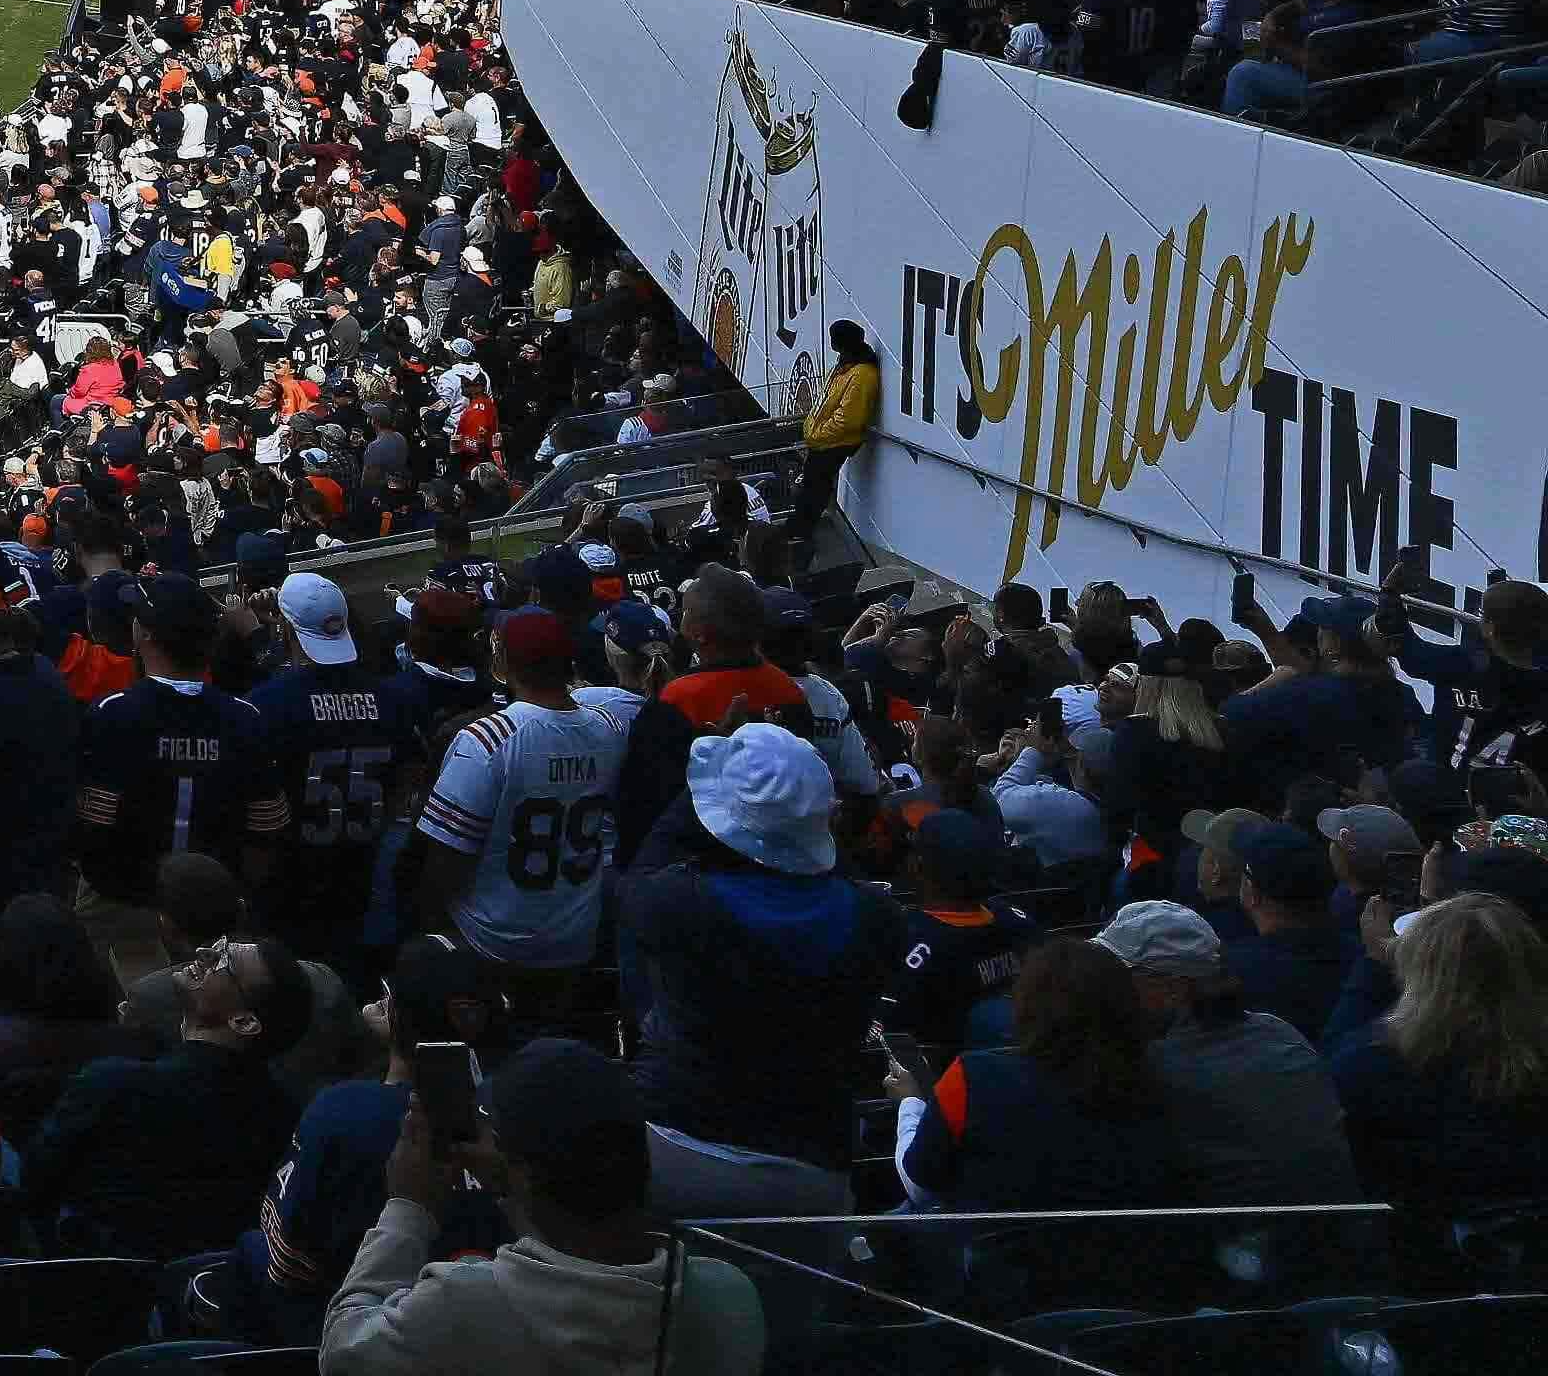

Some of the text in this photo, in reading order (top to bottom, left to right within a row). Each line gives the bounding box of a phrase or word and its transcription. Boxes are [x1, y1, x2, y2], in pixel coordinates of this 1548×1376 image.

[974, 205, 1315, 584] Miller
[627, 570, 664, 589] FORTE
[310, 691, 379, 723] BRIGGS
[158, 735, 220, 762] FIELDS
[548, 756, 597, 784] DITKA
[173, 775, 194, 853] 1
[303, 747, 392, 846] 55
[509, 794, 608, 891] 89
